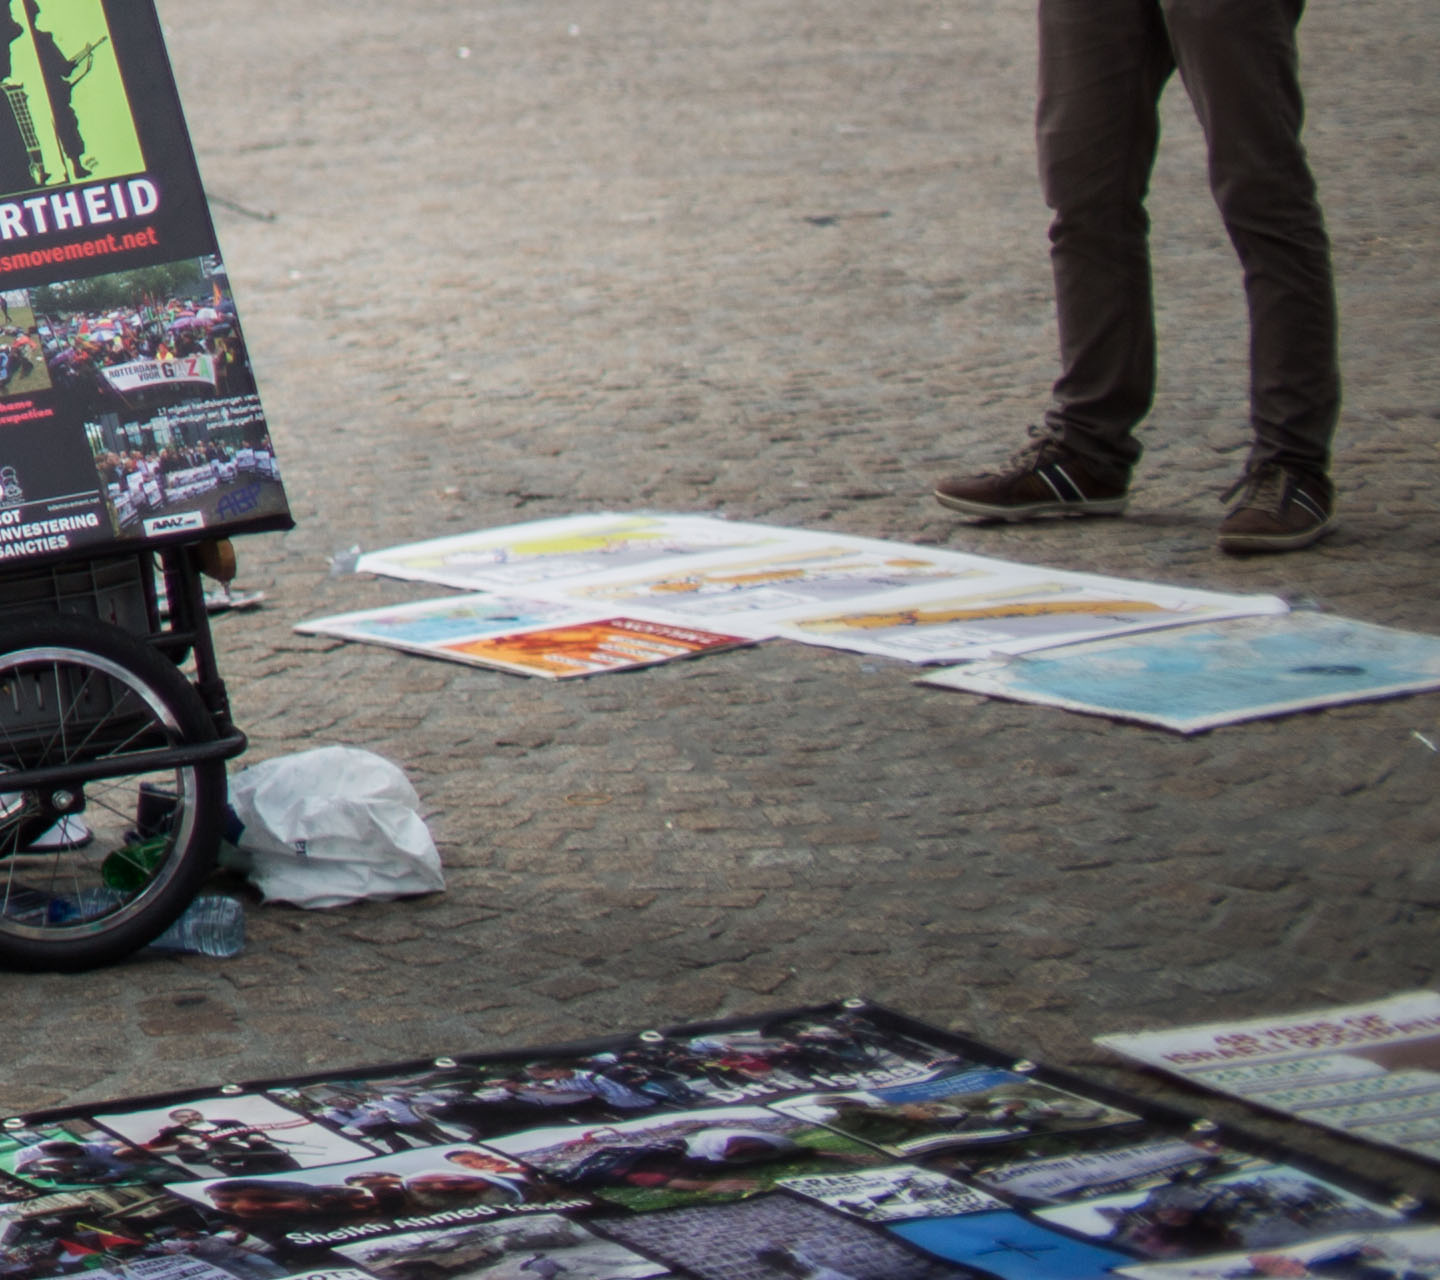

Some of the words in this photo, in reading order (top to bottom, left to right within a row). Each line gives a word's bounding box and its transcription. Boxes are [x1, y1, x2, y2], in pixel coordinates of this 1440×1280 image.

[108, 364, 159, 378] ROTTERDAM
[286, 1222, 389, 1246] Sheikh
[393, 1204, 500, 1229] Ahmed
[496, 1198, 592, 1213] Yassin
